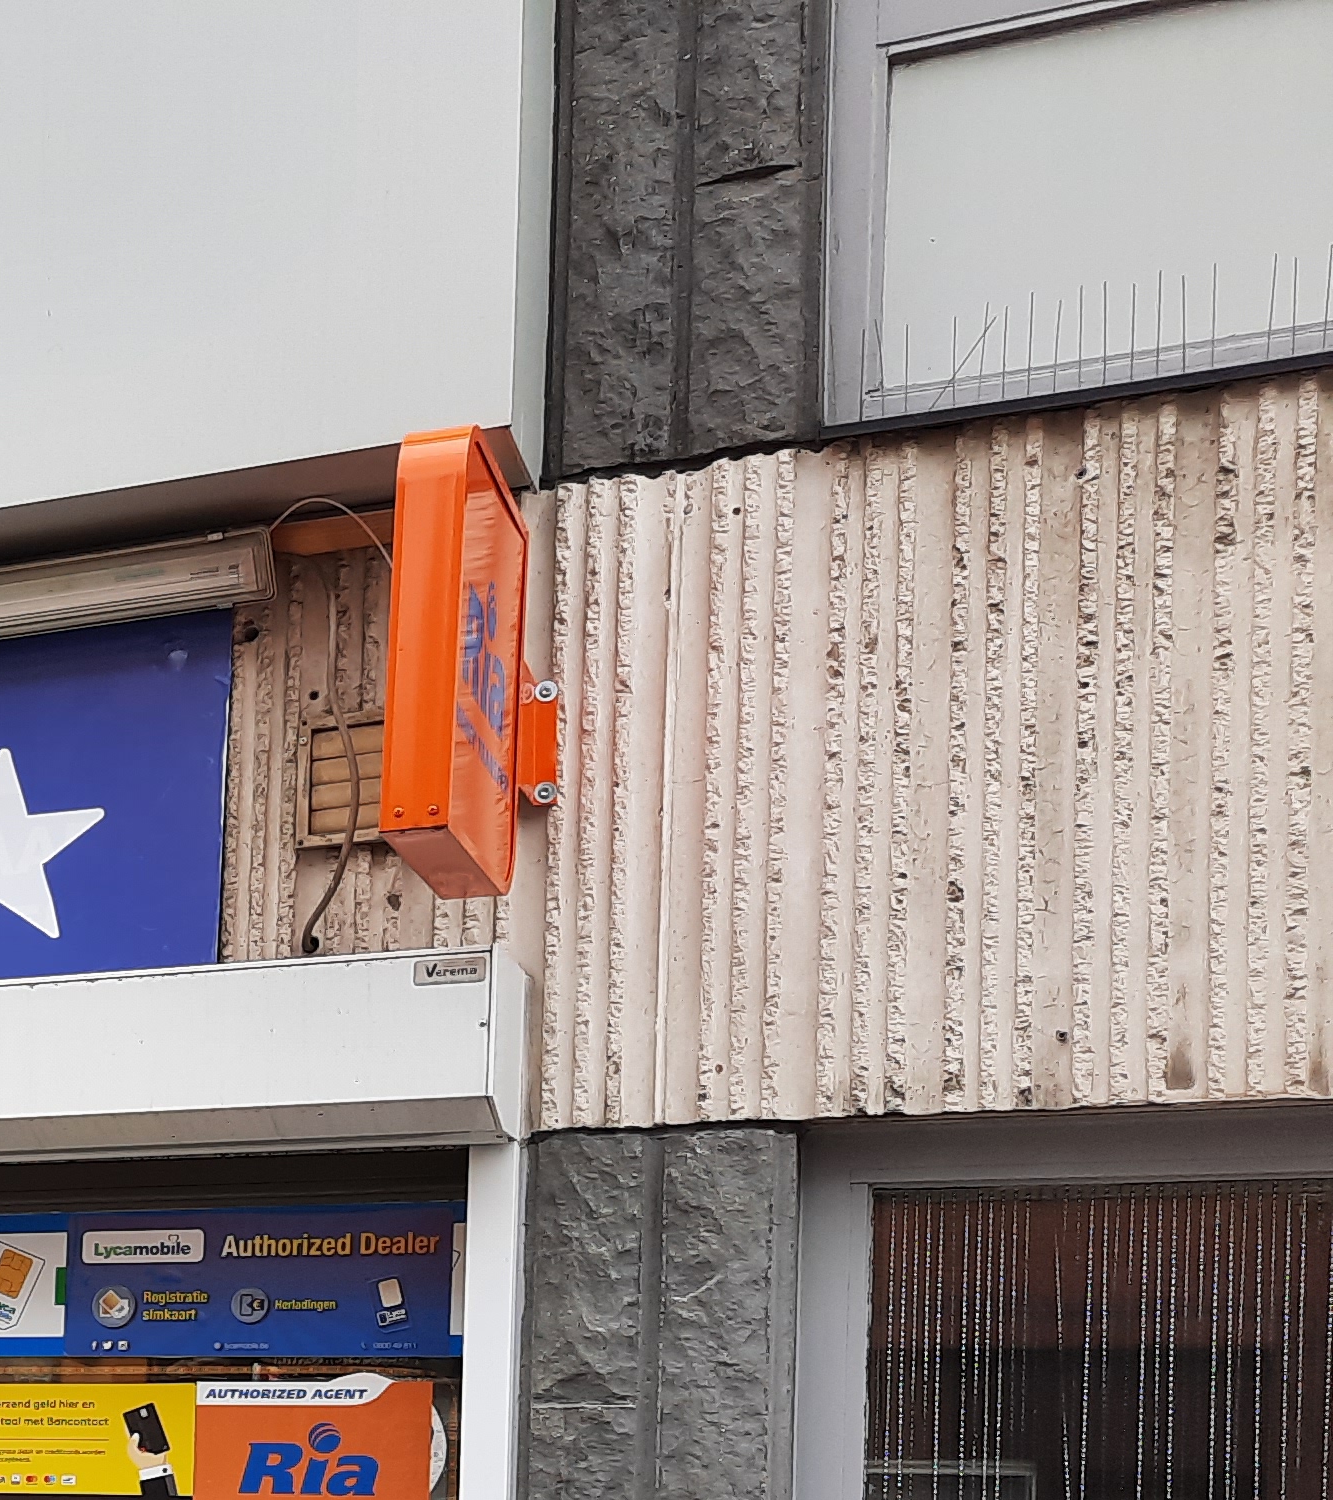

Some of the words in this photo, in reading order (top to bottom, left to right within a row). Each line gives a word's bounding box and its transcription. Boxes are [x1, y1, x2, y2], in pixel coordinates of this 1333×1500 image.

[94, 1239, 191, 1259] Lycamobile
[221, 1232, 351, 1257] Authorized
[359, 1232, 440, 1255] Dealer
[205, 1388, 308, 1400] AUTHORIZED
[312, 1388, 368, 1400] AGENT
[238, 1422, 379, 1496] Ria
